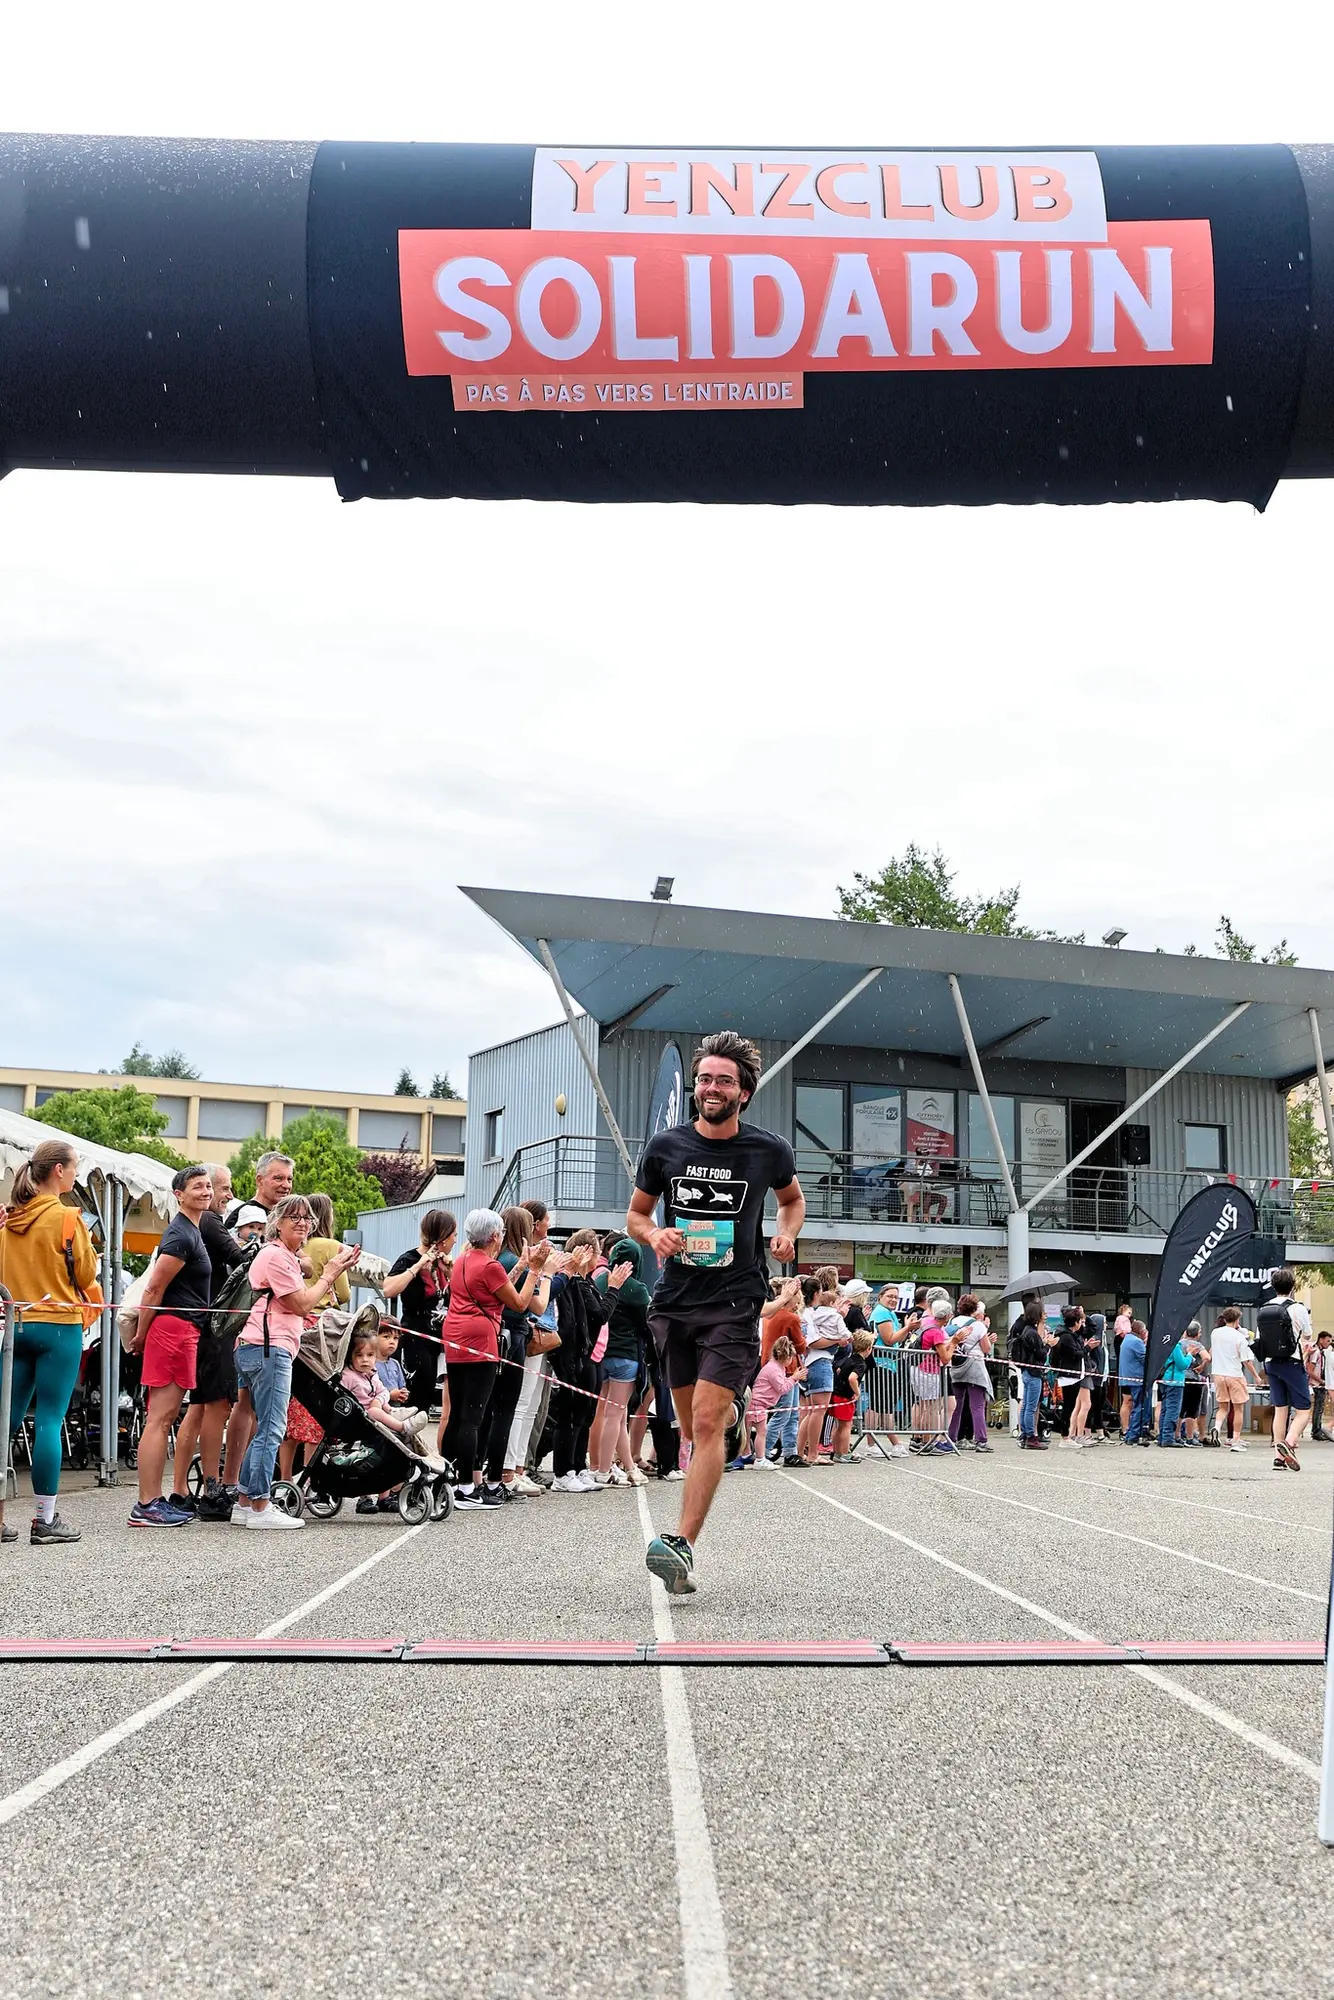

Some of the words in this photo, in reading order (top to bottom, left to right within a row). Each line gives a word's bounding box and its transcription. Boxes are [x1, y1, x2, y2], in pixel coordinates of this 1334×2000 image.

[552, 158, 1074, 224] YENZCLUB
[433, 246, 1176, 363] SOLIDARUN
[466, 384, 509, 403] PAS
[518, 377, 534, 403] À
[543, 384, 586, 403] PAS
[595, 384, 654, 402] VERS
[664, 381, 794, 402] L'ENTRAIDE
[686, 1165, 709, 1178] FAST
[708, 1167, 732, 1180] FOOD
[691, 1240, 711, 1251] 123
[1179, 1202, 1238, 1287] YENZCLUB
[895, 1256, 944, 1265] ATTITUDE
